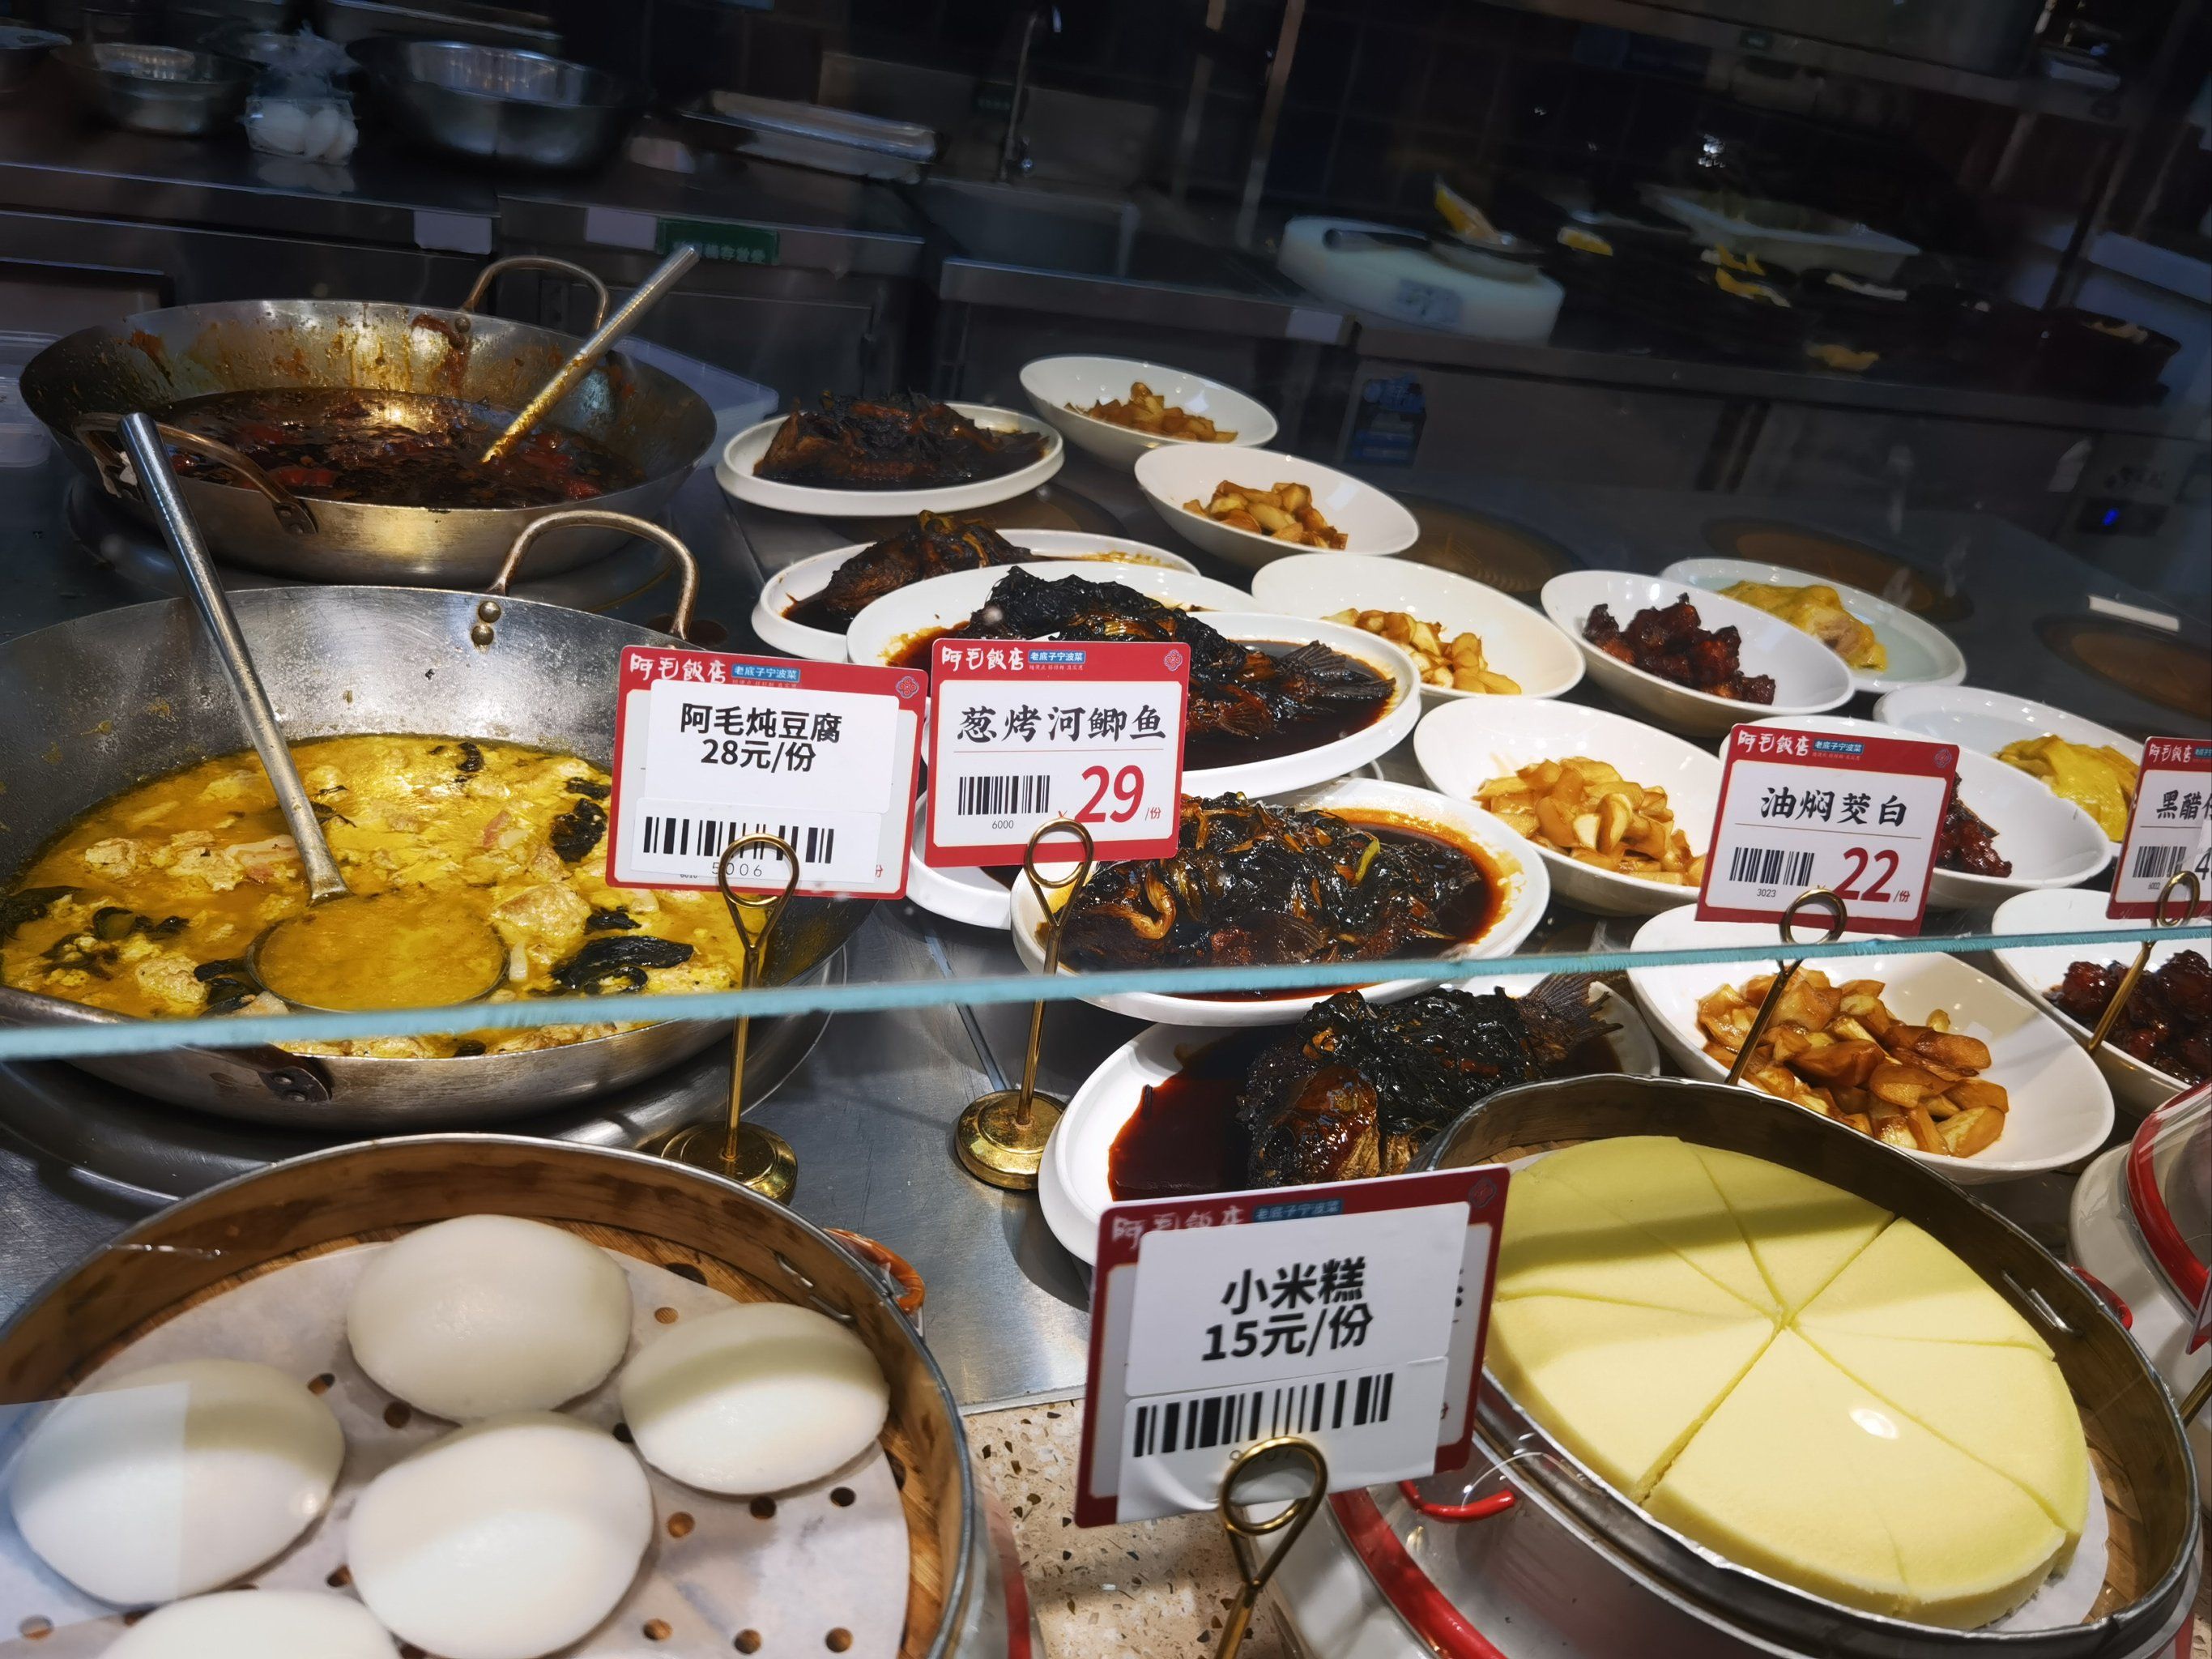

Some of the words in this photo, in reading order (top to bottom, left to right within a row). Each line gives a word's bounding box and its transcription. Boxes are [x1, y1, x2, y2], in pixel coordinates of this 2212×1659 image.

[734, 665, 798, 680] 老底子宁波菜
[1030, 651, 1084, 662] 老底子宁波菜
[680, 702, 842, 743] 阿毛炖豆腐
[957, 704, 1166, 744] 葱烤河鲫鱼
[701, 738, 816, 773] 28元/份
[1075, 765, 1144, 823] 29
[1759, 786, 1907, 827] 油焖茭白
[991, 820, 1014, 830] 6000
[711, 861, 763, 877] 5006
[1833, 847, 1899, 902] 22
[1756, 888, 1776, 898] 3023
[1220, 1256, 1366, 1316] 小米糕
[1200, 1303, 1373, 1362] 15元/份
